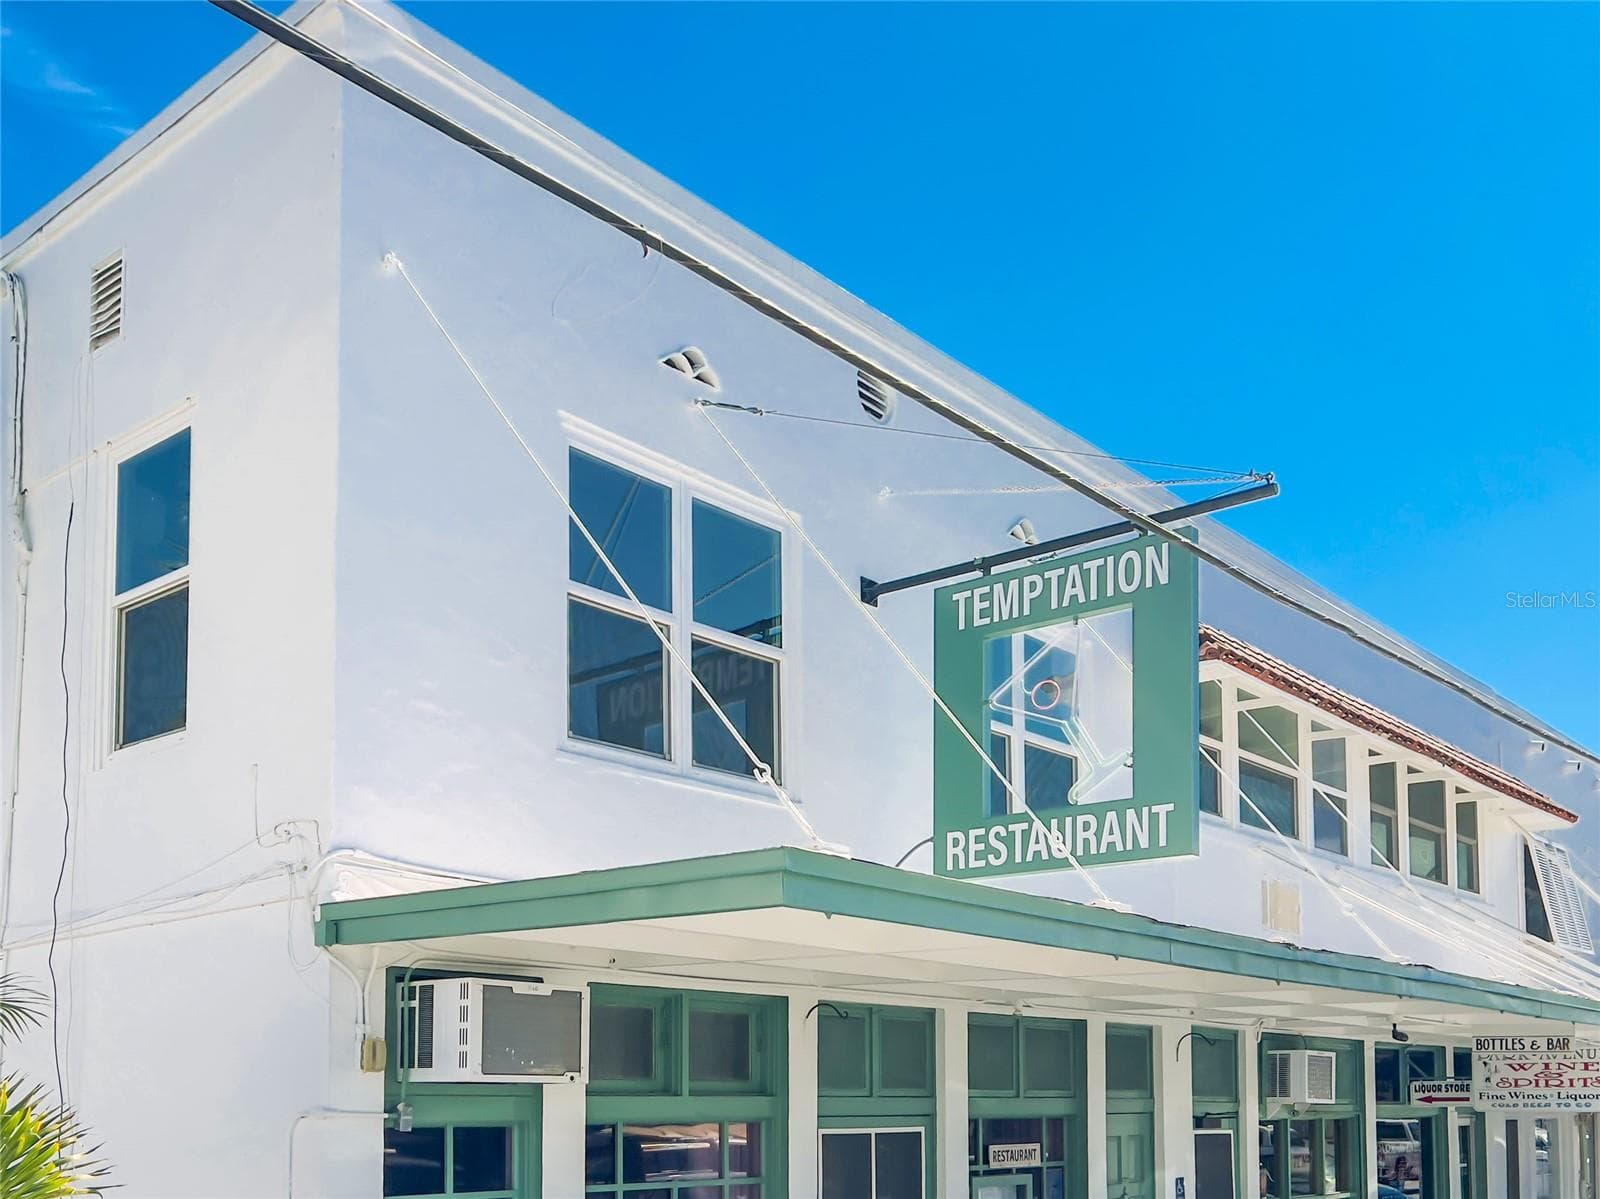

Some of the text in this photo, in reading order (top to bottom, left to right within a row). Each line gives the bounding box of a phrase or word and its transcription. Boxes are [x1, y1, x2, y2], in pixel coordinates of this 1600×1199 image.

[952, 542, 1170, 631] TEMPTATION
[946, 803, 1175, 871] RESTAURANT
[1475, 1038, 1570, 1051] BOTTLES & BAR
[1504, 1061, 1600, 1072] WINE
[1414, 1083, 1471, 1094] LIQUOR STORE
[1479, 1091, 1506, 1100] Fine
[1508, 1091, 1548, 1100] Wines
[992, 1148, 1037, 1162] RESTAURANT
